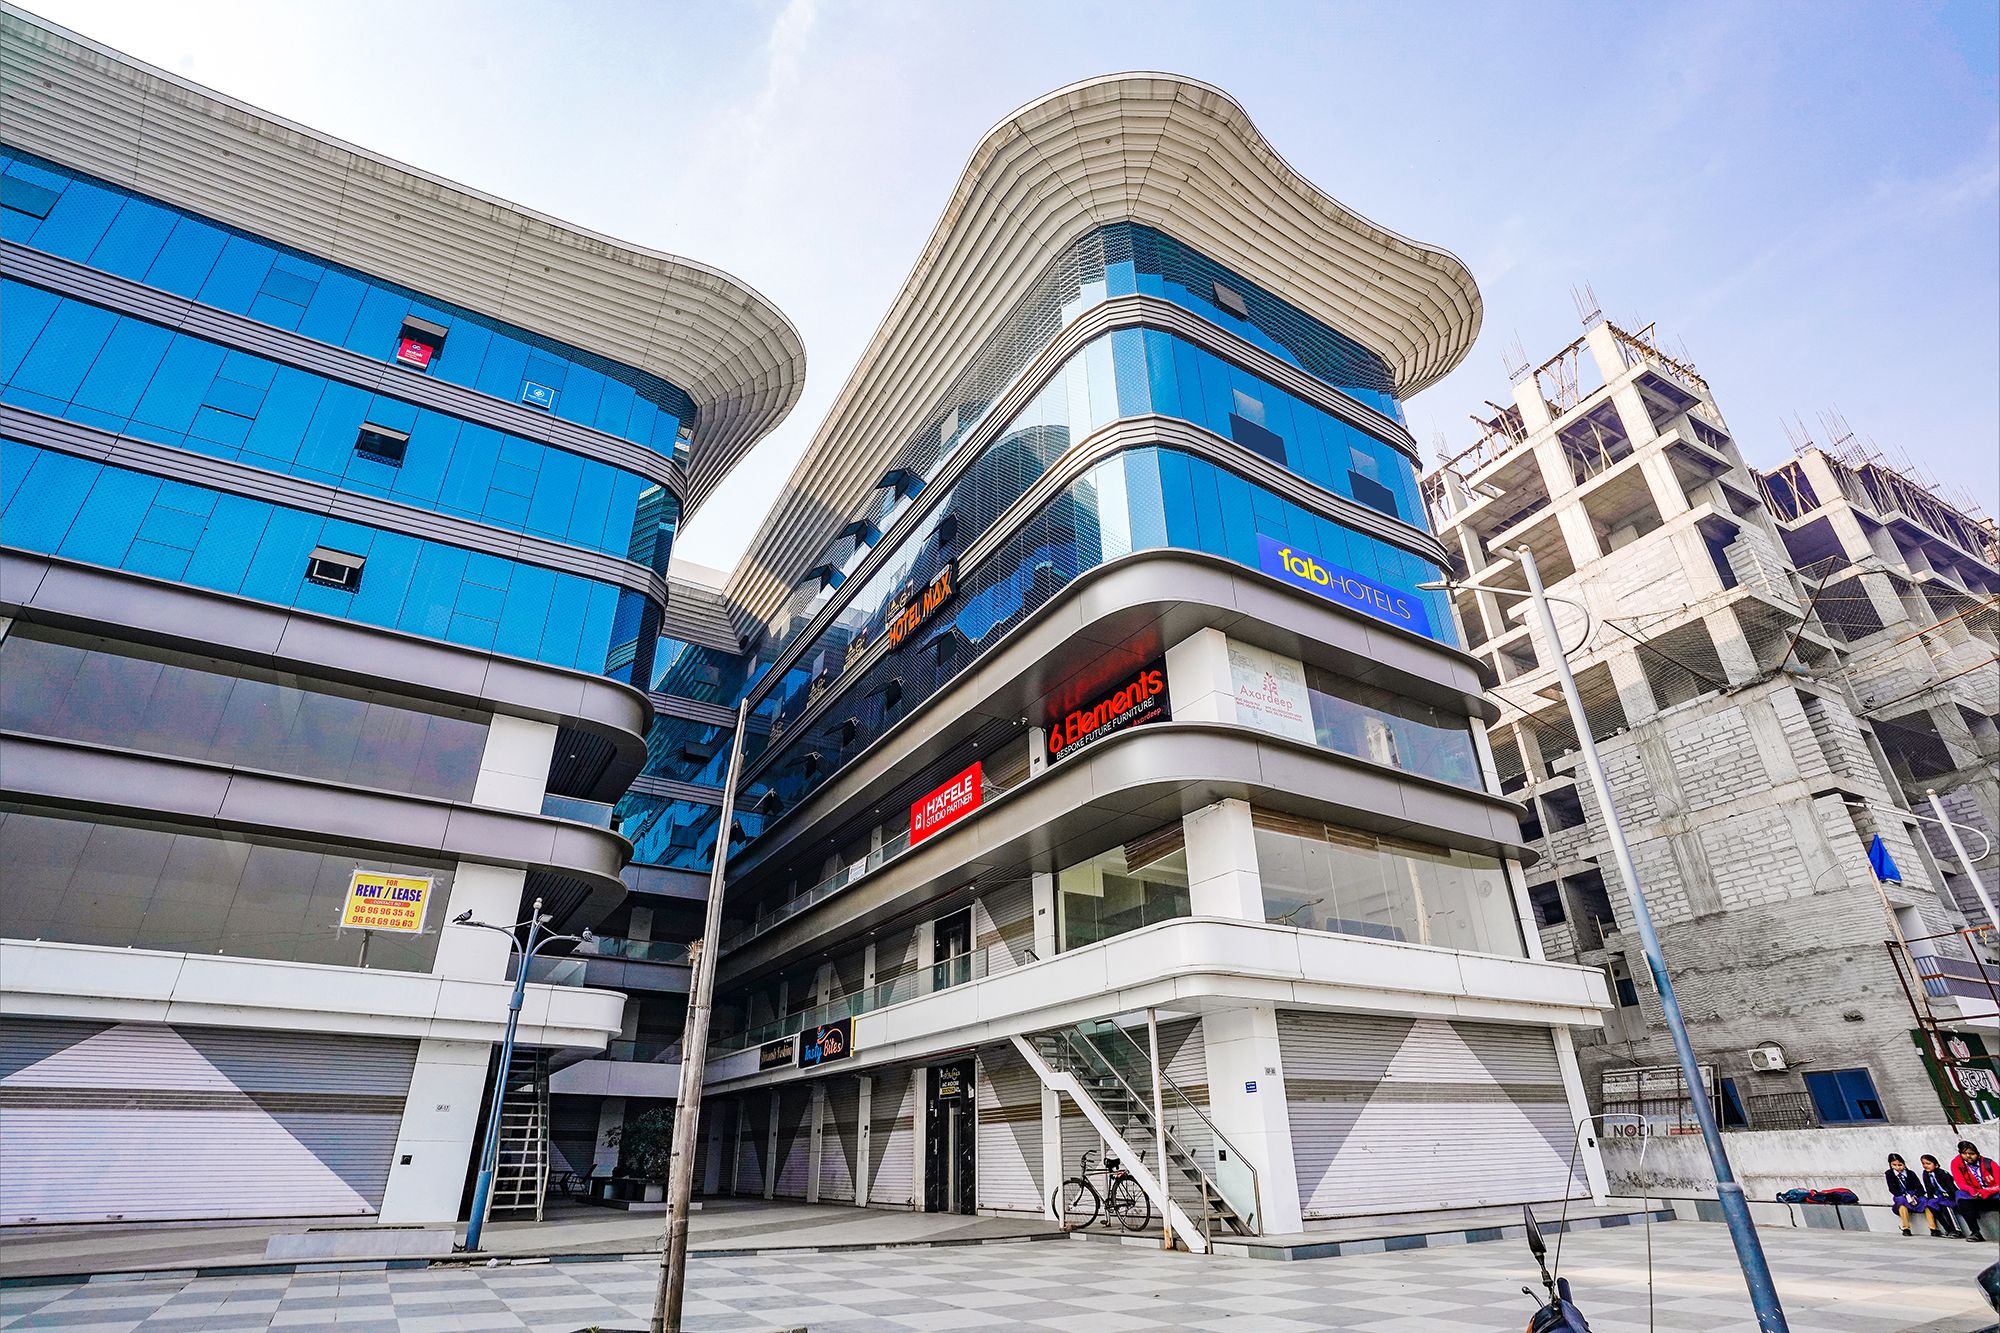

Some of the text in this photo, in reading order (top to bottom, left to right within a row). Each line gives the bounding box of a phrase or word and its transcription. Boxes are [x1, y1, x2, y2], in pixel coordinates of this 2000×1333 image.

[889, 602, 921, 650] HOTEL
[923, 570, 952, 619] MAX
[1049, 670, 1163, 753] 6 Elements
[1240, 685, 1293, 711] Axardeep
[1056, 735, 1085, 760] BESPOKE
[1085, 718, 1112, 744] FUTURE
[926, 792, 973, 828] STUDIO PARTNER
[927, 774, 973, 817] HÄFELE
[354, 905, 366, 913] 96
[367, 906, 378, 914] 96
[380, 908, 390, 916] 96
[392, 909, 403, 917] 35
[355, 884, 384, 898] RENT
[391, 887, 422, 902] LEASE
[804, 1038, 842, 1065] Tasty Bites
